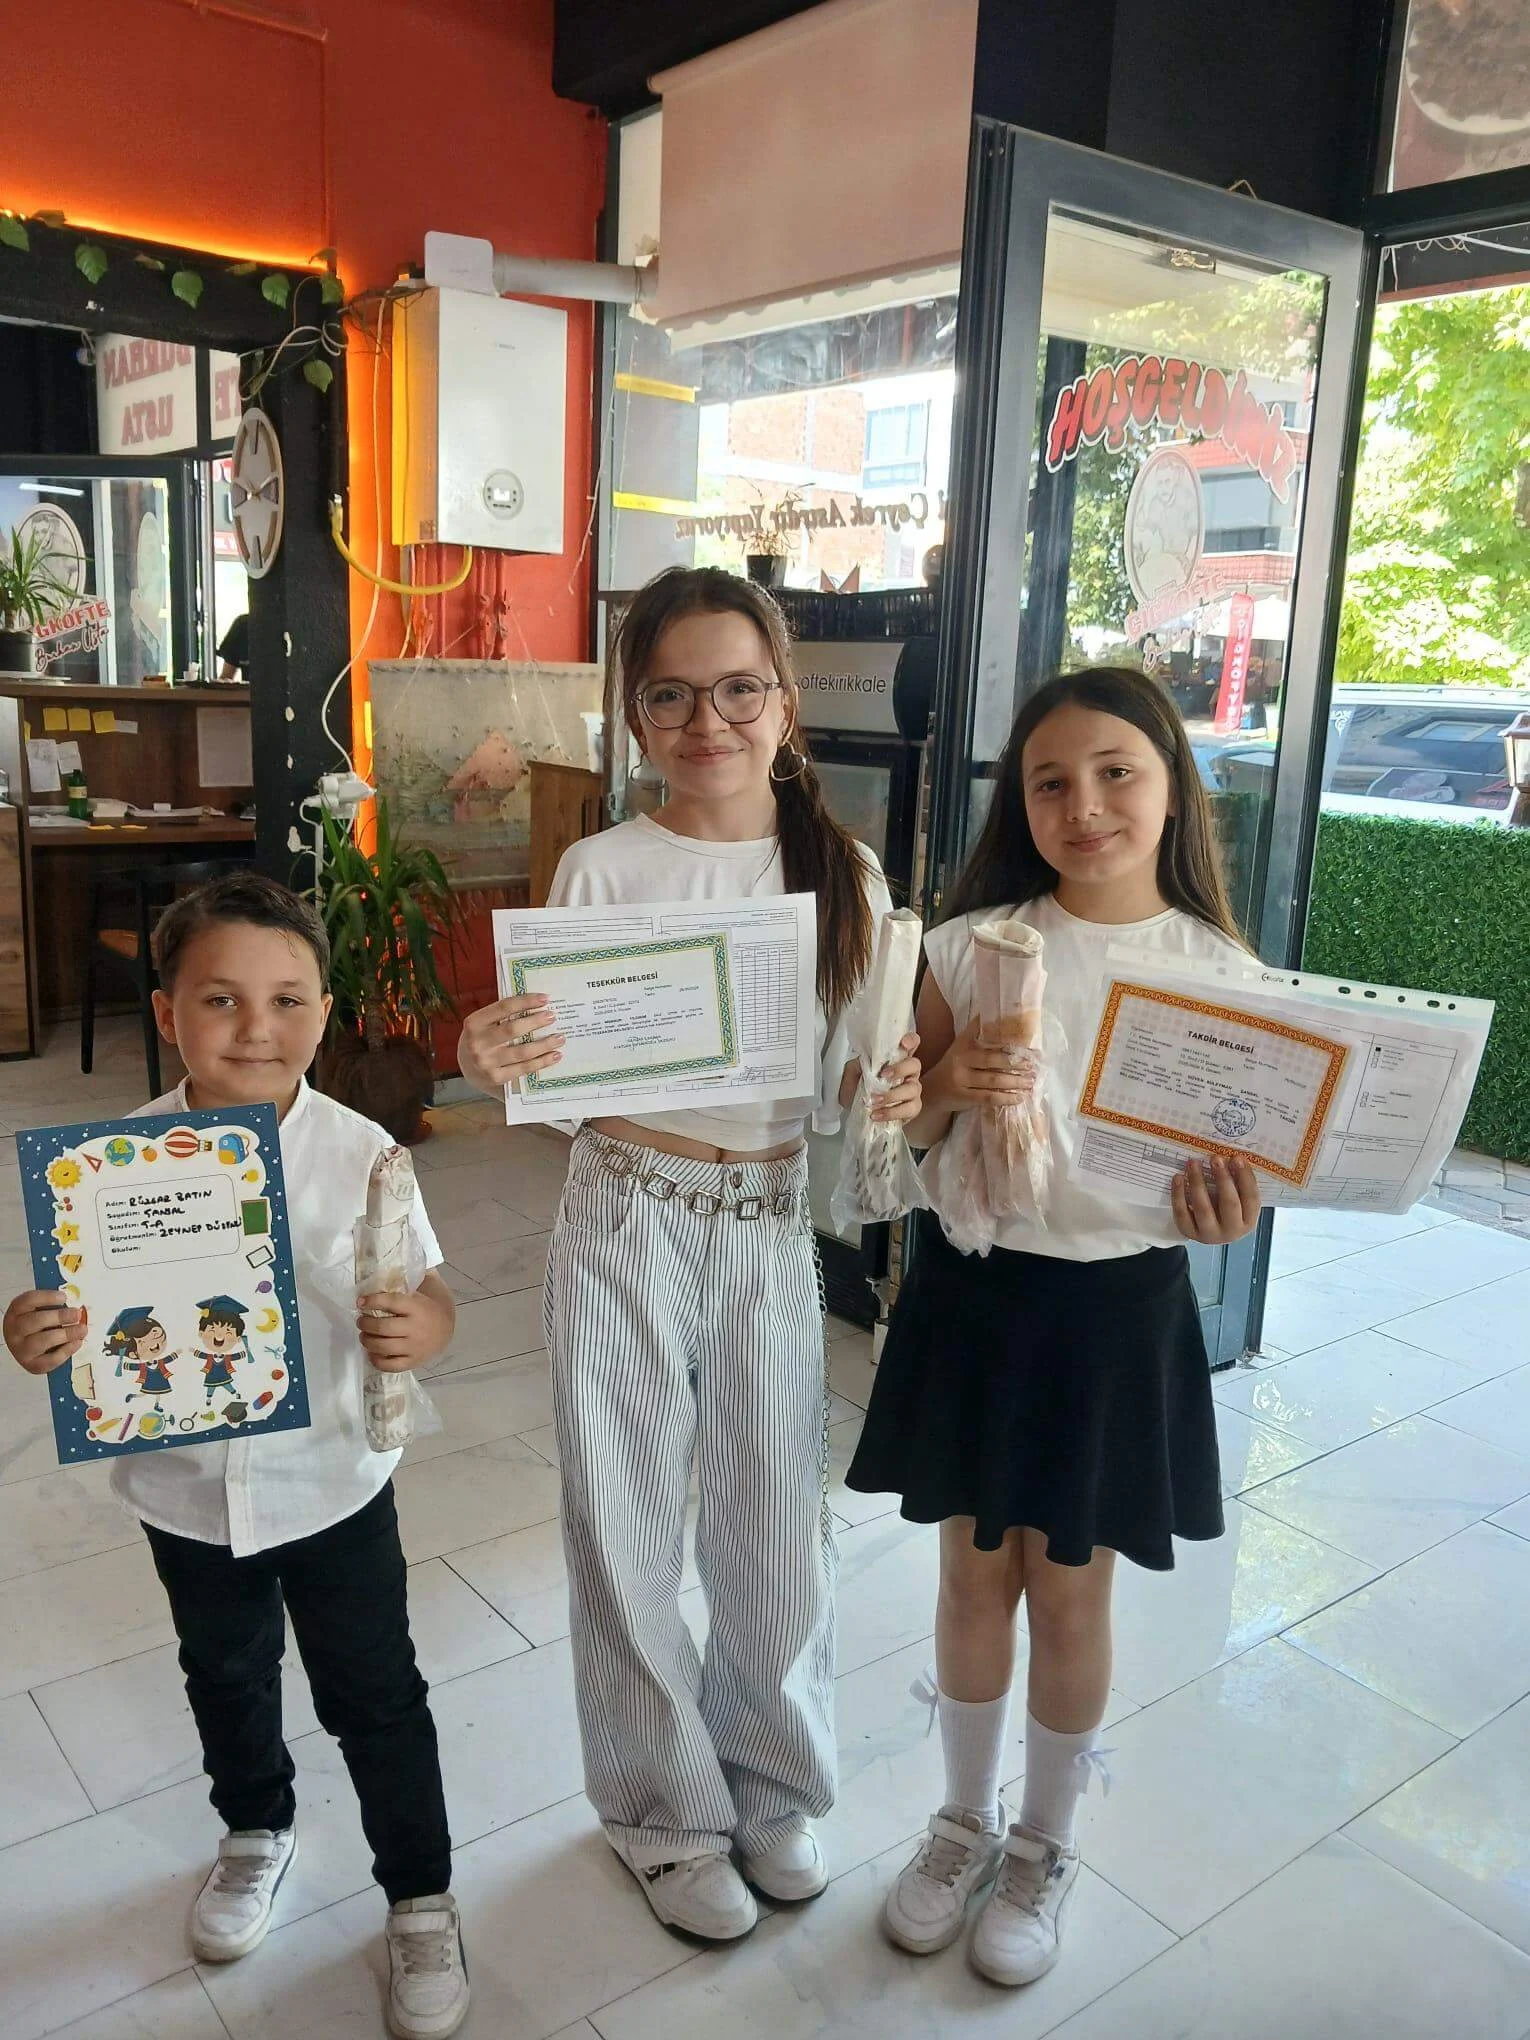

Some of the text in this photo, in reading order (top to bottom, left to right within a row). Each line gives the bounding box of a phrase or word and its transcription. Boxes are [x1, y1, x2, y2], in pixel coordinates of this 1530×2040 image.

[796, 673, 887, 693] oftekirikkale
[586, 970, 659, 990] TEŞEKKÜR BELGESİ
[1187, 1030, 1218, 1046] TAKDİR
[1219, 1038, 1255, 1055] BELGESİ
[159, 1224, 202, 1238] ZEYNEP
